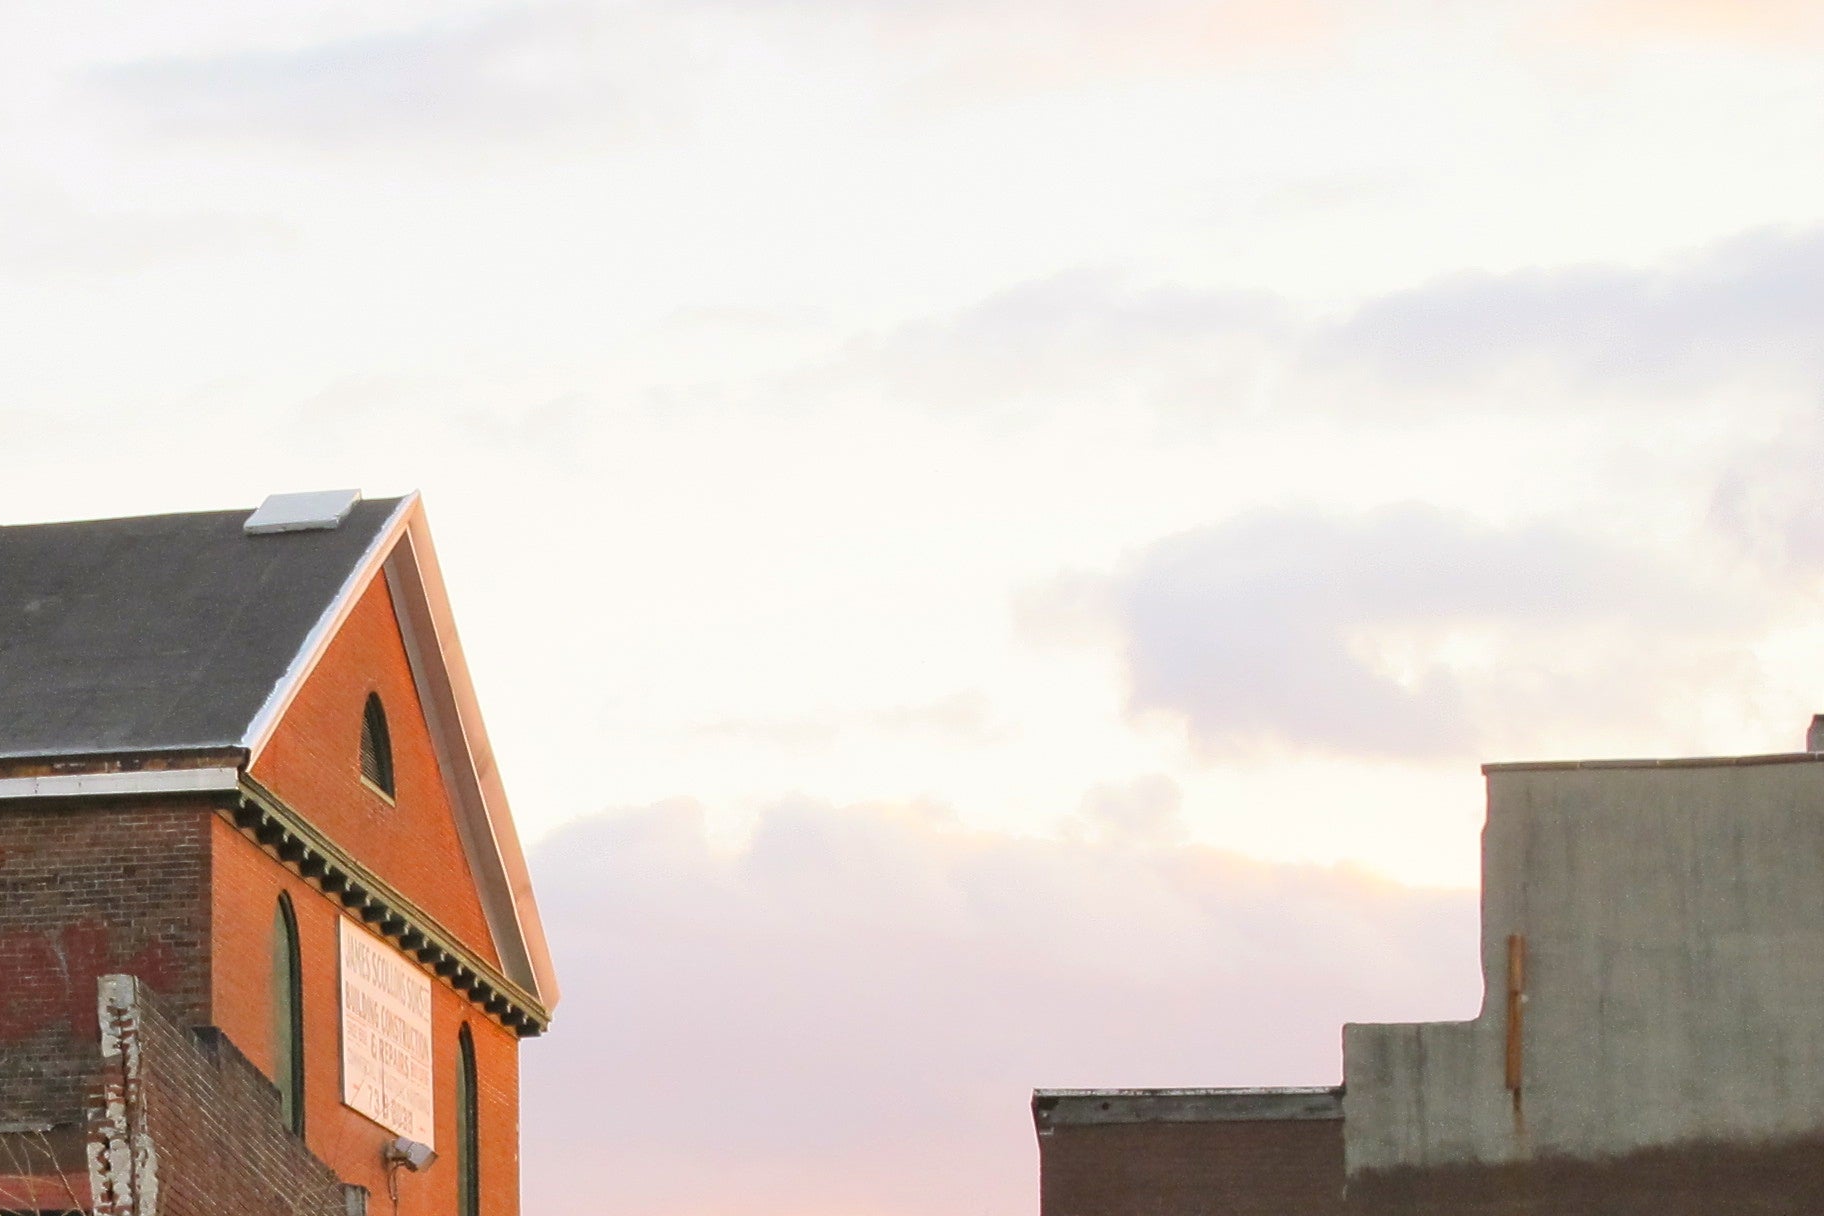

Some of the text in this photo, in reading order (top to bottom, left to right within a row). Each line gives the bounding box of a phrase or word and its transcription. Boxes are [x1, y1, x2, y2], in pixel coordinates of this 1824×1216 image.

[345, 932, 370, 980] JAMES
[345, 981, 379, 1027] BUILDING
[380, 1005, 429, 1062] CONSTRUCTION
[378, 1038, 408, 1077] REPAIRS
